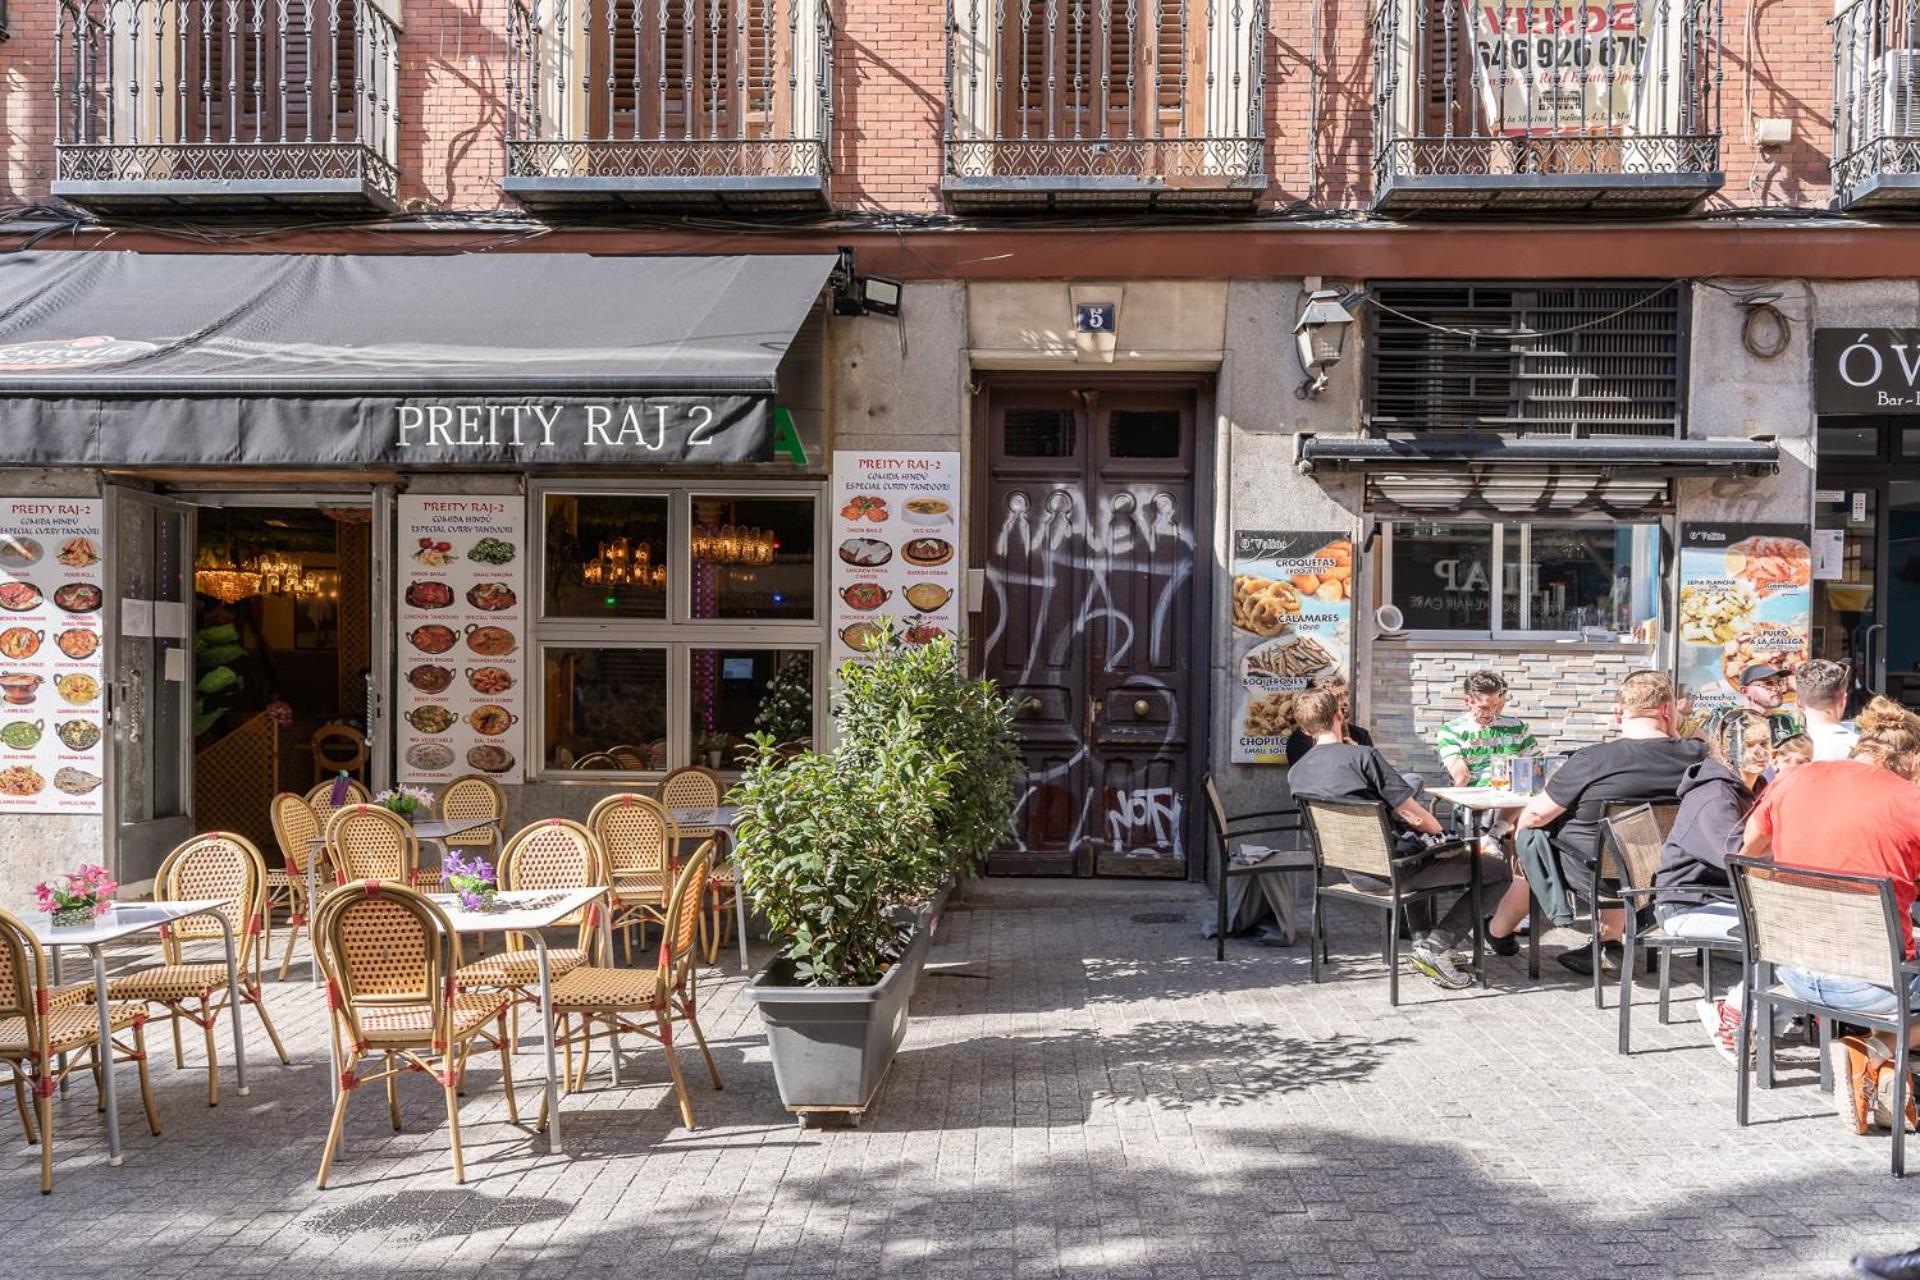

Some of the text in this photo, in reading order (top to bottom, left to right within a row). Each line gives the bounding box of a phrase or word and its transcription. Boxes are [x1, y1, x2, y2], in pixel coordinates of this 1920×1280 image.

[1483, 2, 1637, 35] VENDE
[1477, 35, 1648, 69] 646 926 676
[1089, 307, 1103, 328] 5
[1876, 390, 1904, 406] Bar
[395, 405, 713, 451] PREITY RAJ 2
[1275, 558, 1336, 568] CROQUETAS
[1278, 614, 1340, 623] CALAMARES
[1239, 737, 1289, 746] CHOPITO
